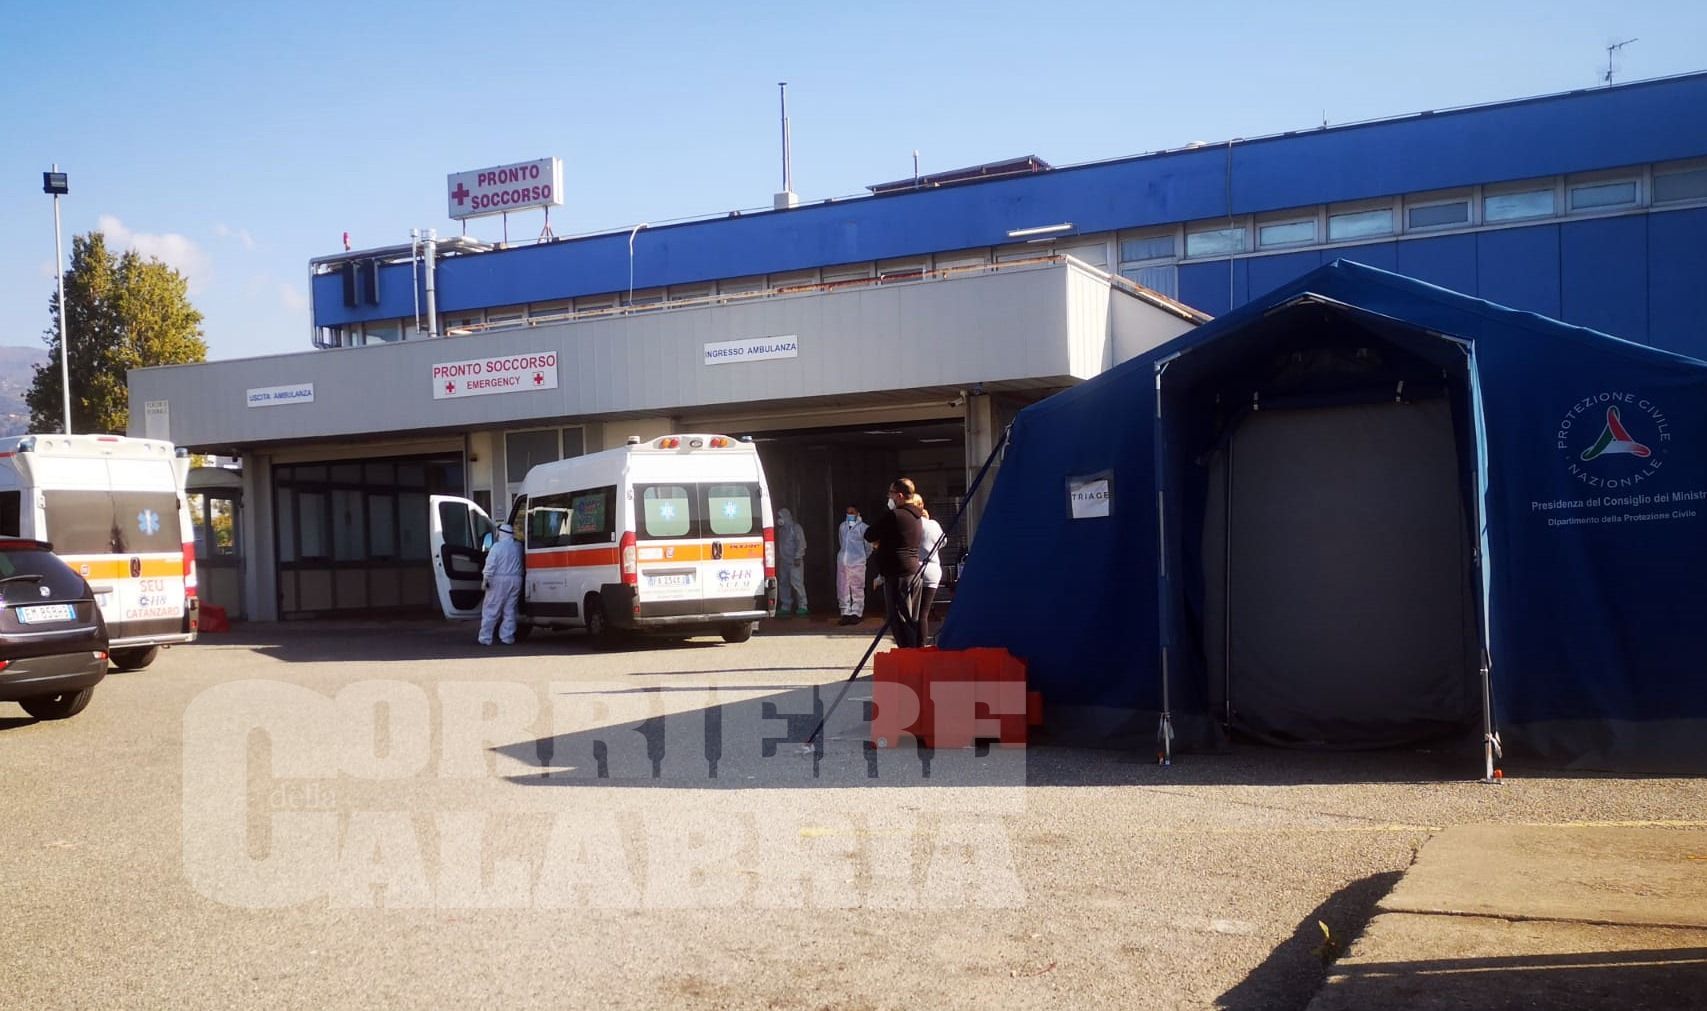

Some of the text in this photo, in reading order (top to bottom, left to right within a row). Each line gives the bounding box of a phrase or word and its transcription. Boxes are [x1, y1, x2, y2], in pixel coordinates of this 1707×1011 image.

[478, 165, 539, 187] PRONTO
[472, 185, 551, 209] SOCCORSO
[747, 343, 796, 355] AMBULANZA
[433, 355, 555, 378] PRONTO SOCCORSO
[466, 376, 520, 389] EMERGENCY
[1558, 392, 1671, 449] PROTEZIONE CIVILE
[1568, 459, 1663, 489] NAZIONALE
[1071, 491, 1111, 501] TRIAGE
[1531, 499, 1584, 512] Presidenza
[1586, 498, 1600, 508] del
[1603, 495, 1651, 507] Consiglio
[1654, 493, 1669, 503] dei
[1547, 509, 1697, 527] Dipartimento della Protezione Civile
[140, 579, 164, 593] SEU
[127, 607, 180, 618] CATANZARO
